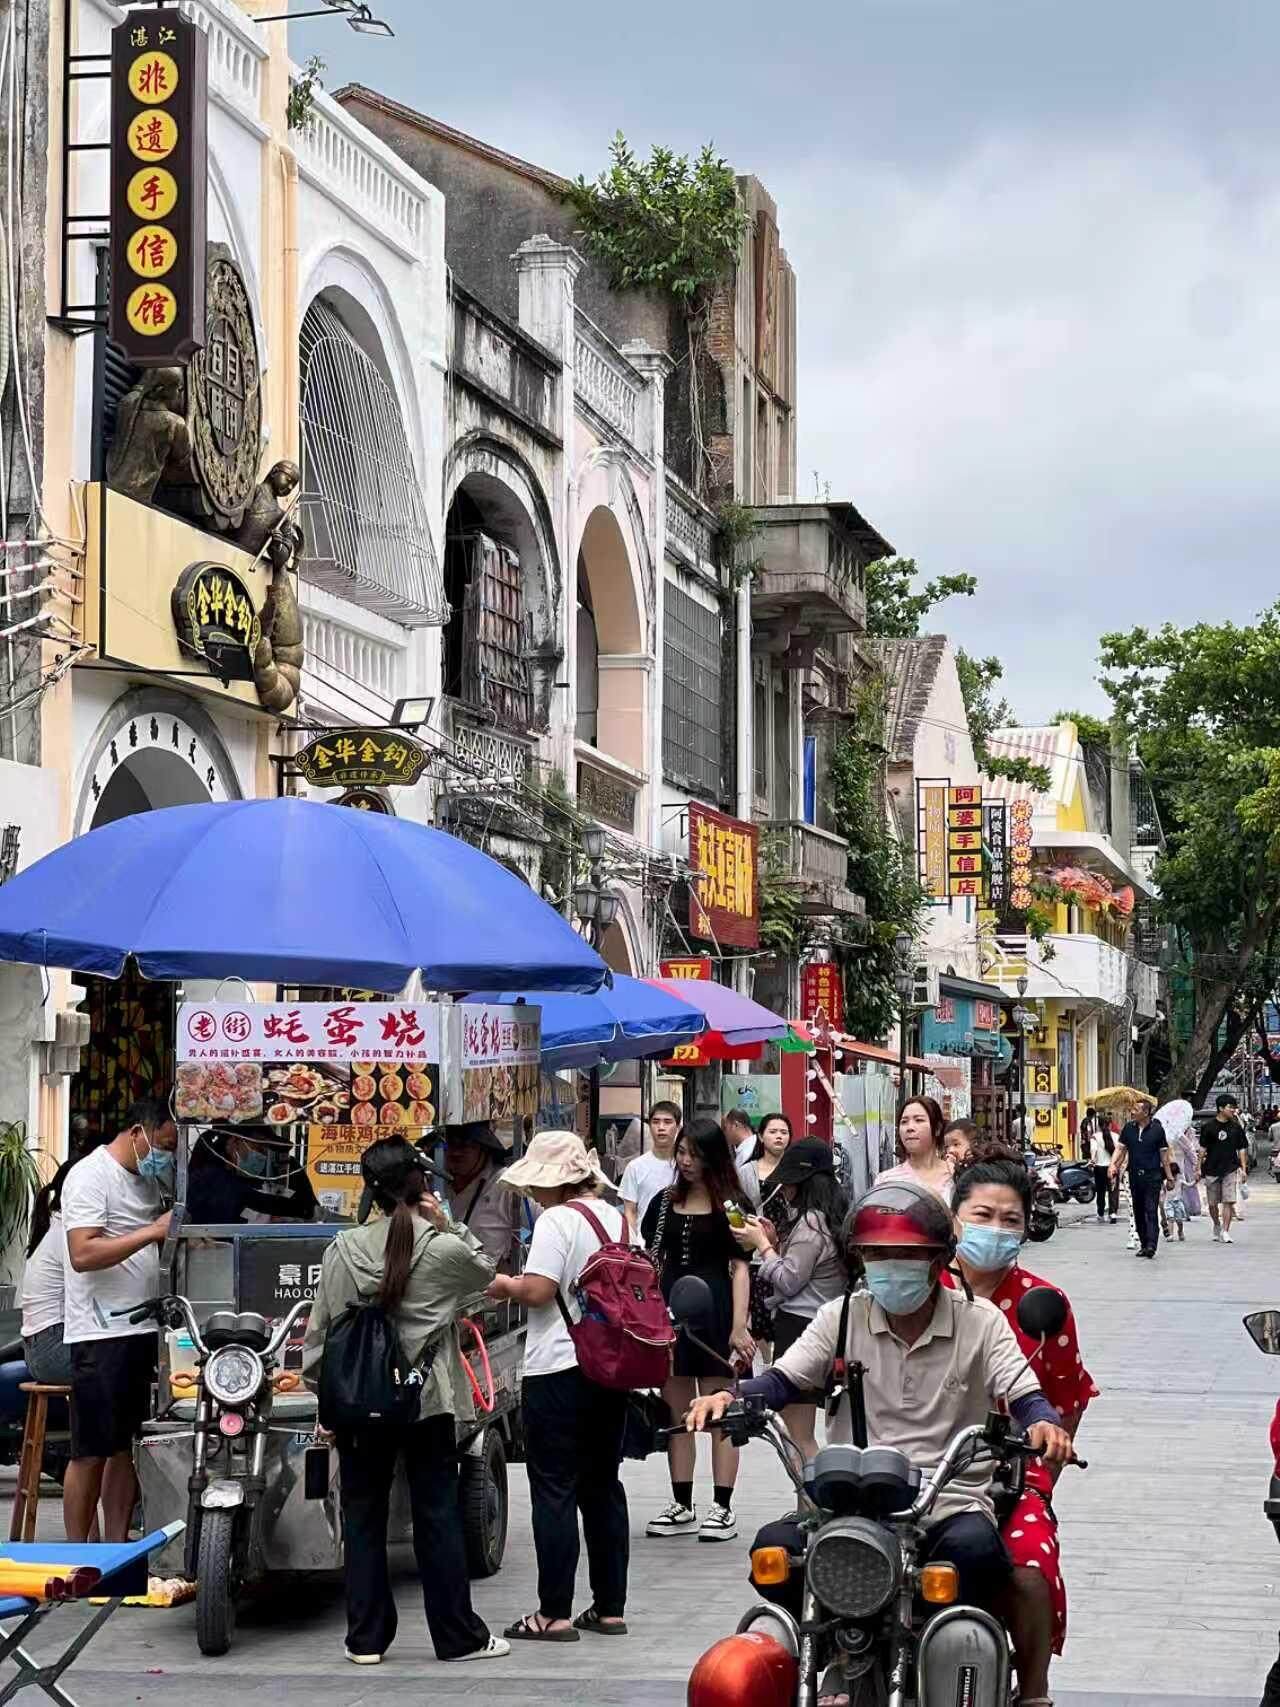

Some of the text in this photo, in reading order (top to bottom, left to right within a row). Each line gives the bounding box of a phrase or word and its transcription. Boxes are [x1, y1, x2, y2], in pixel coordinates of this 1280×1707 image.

[131, 26, 176, 47] 湛江
[136, 61, 170, 327] 非遗手信馆
[955, 788, 976, 893] 阿婆手信店
[190, 1012, 250, 1041] 老街
[264, 1007, 425, 1047] 蚝蛋烧
[274, 1288, 301, 1299] HAO
